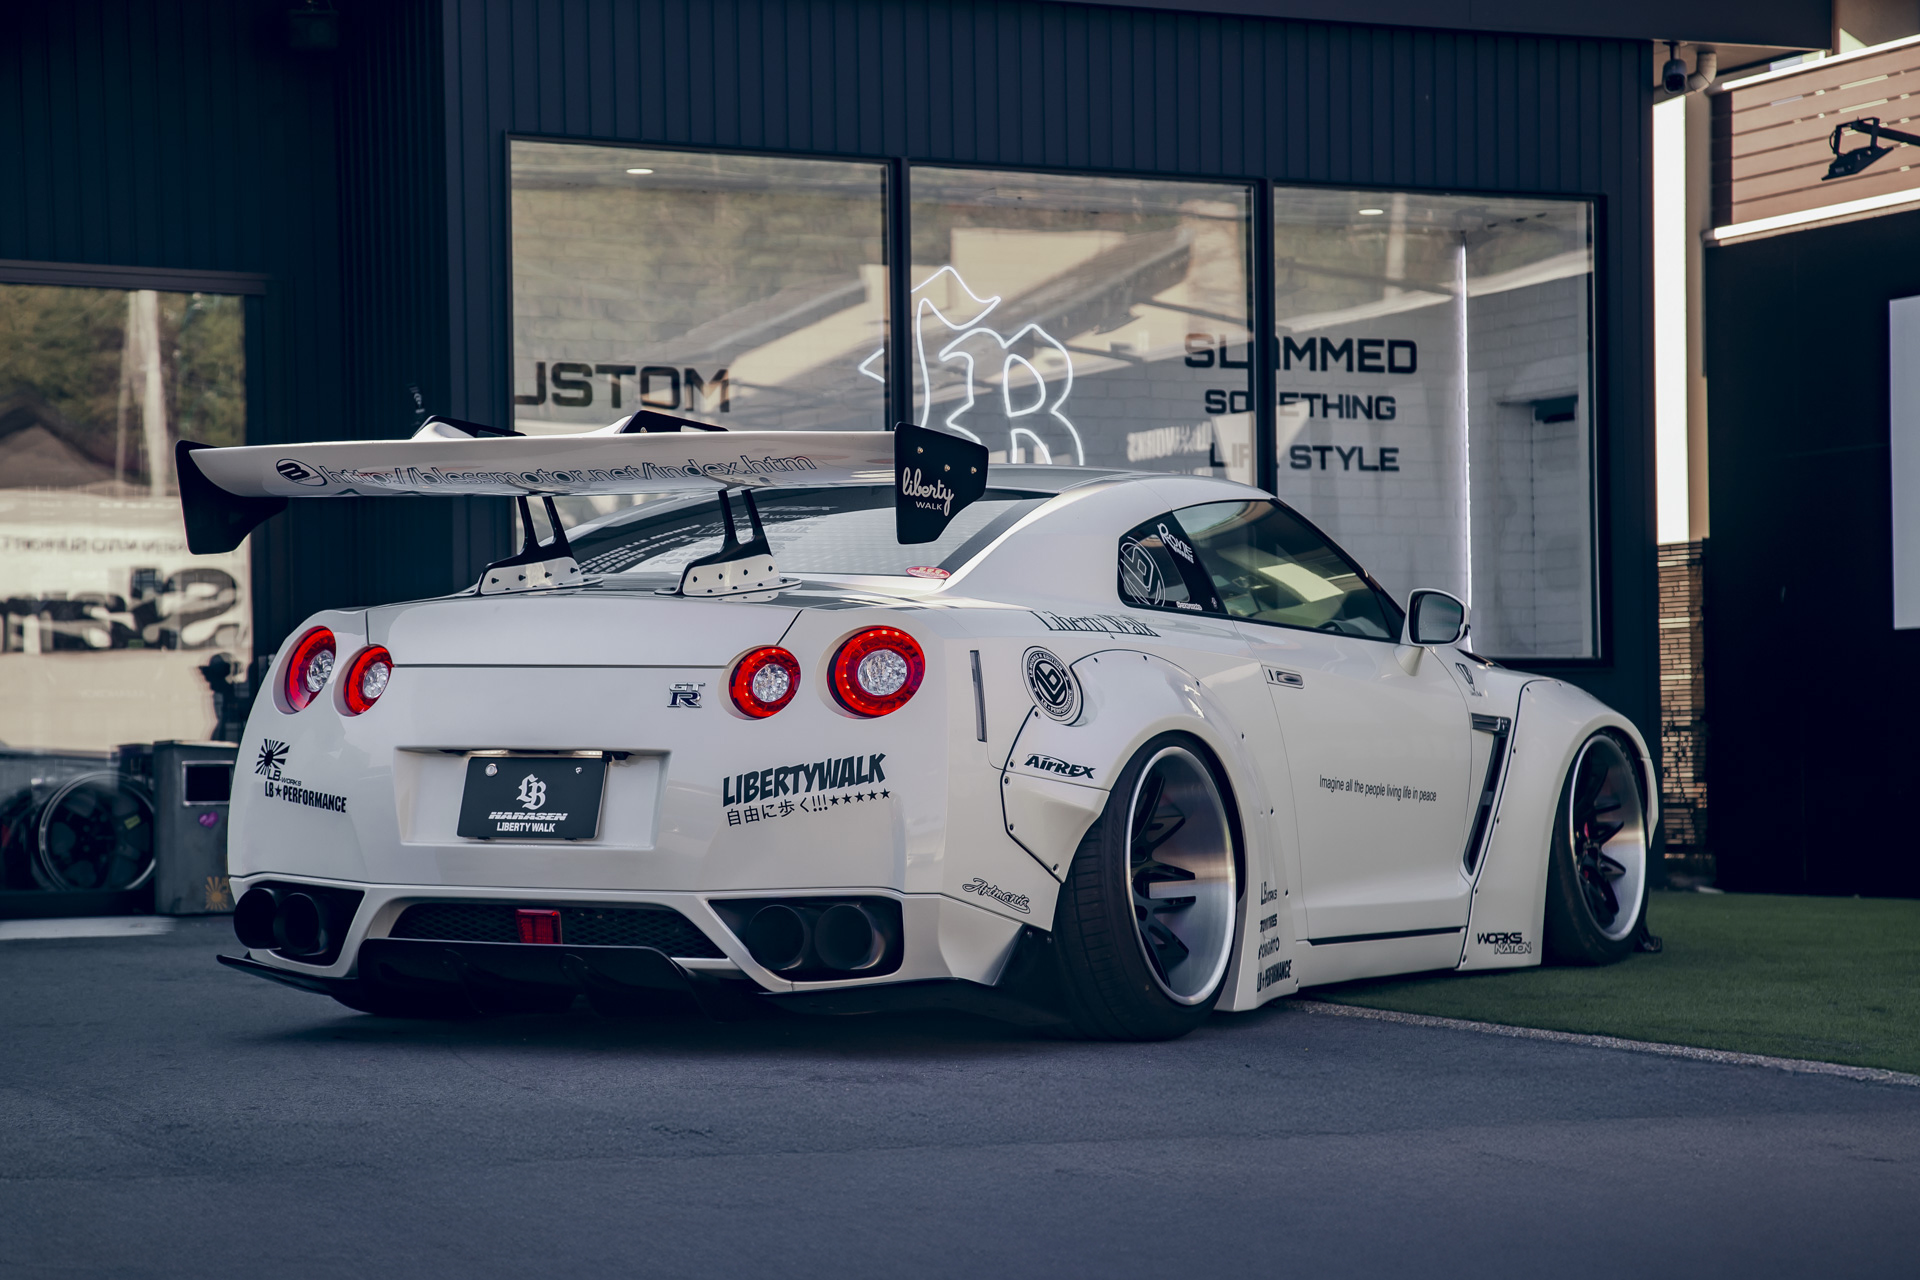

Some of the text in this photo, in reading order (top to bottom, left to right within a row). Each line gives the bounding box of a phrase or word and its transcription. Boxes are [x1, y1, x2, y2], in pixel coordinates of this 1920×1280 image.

[1184, 333, 1418, 375] SLMMED
[1205, 389, 1397, 421] SOETHING
[1210, 442, 1400, 472] LIF STYLE
[902, 467, 955, 517] liberty
[915, 501, 943, 511] WALK
[283, 785, 348, 813] PERFORMANCE
[1319, 774, 1437, 803] Imagine all the people living life in peace
[488, 811, 568, 822] HARASEN
[496, 822, 556, 833] LIBERTY WALK
[1477, 931, 1523, 945] WORKS
[1494, 941, 1532, 955] NATION
